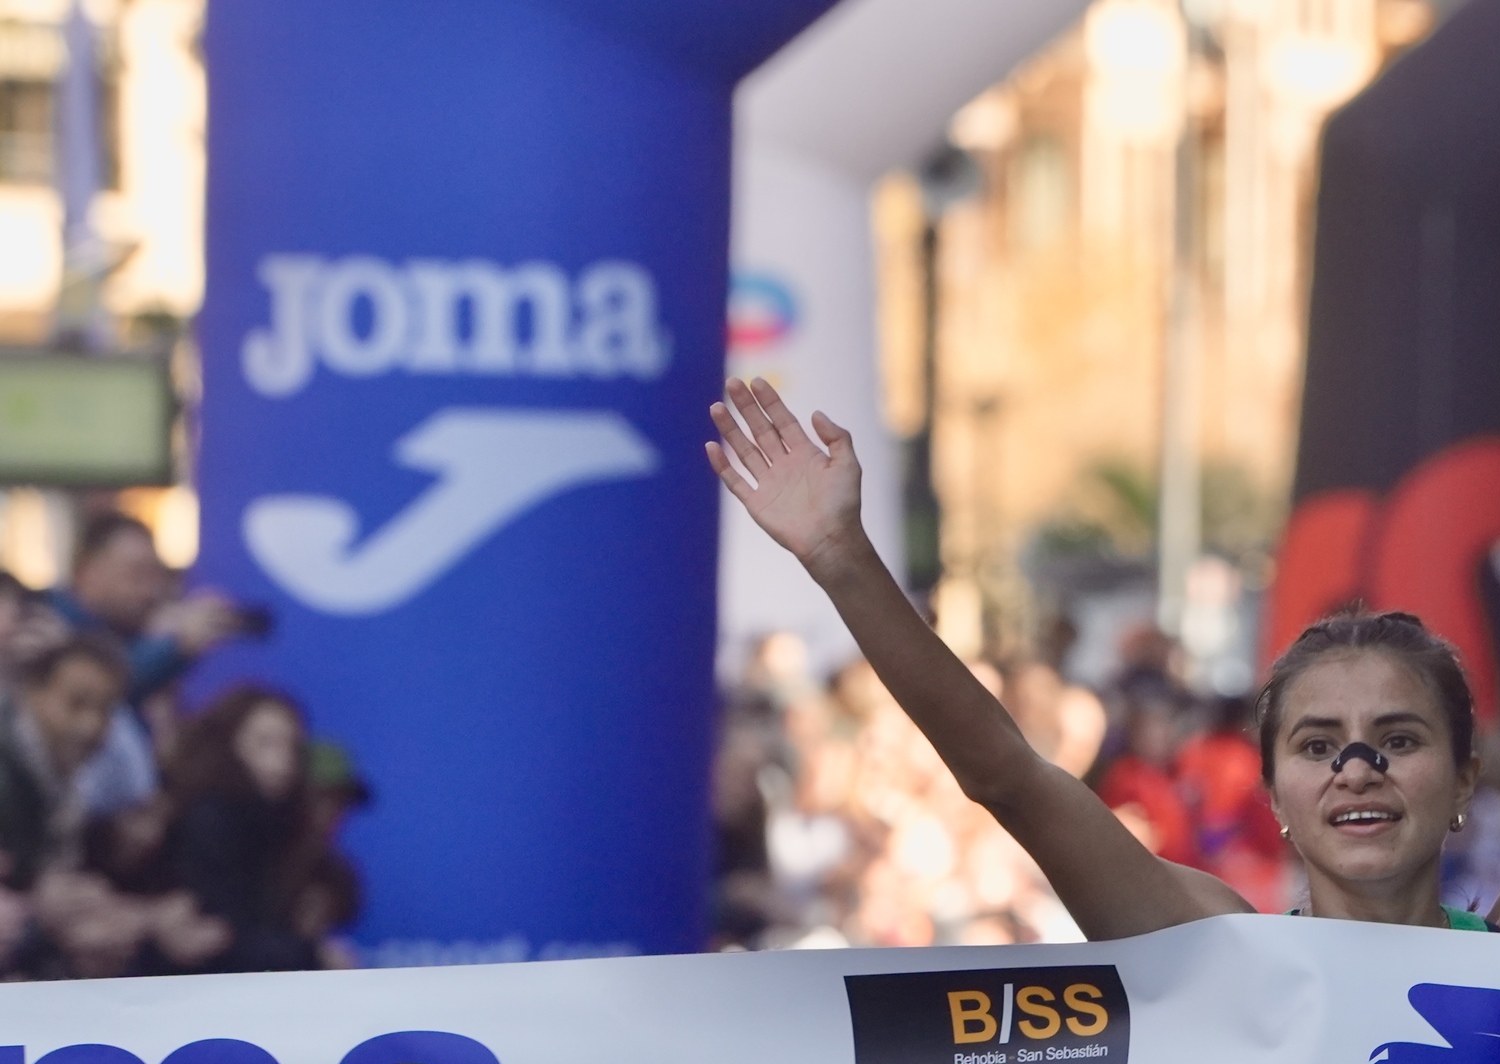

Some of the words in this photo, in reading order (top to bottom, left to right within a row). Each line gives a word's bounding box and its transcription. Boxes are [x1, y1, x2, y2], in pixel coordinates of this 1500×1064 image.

[242, 254, 672, 397] Joma
[1017, 1049, 1042, 1063] San
[1046, 1043, 1109, 1061] Sebastián
